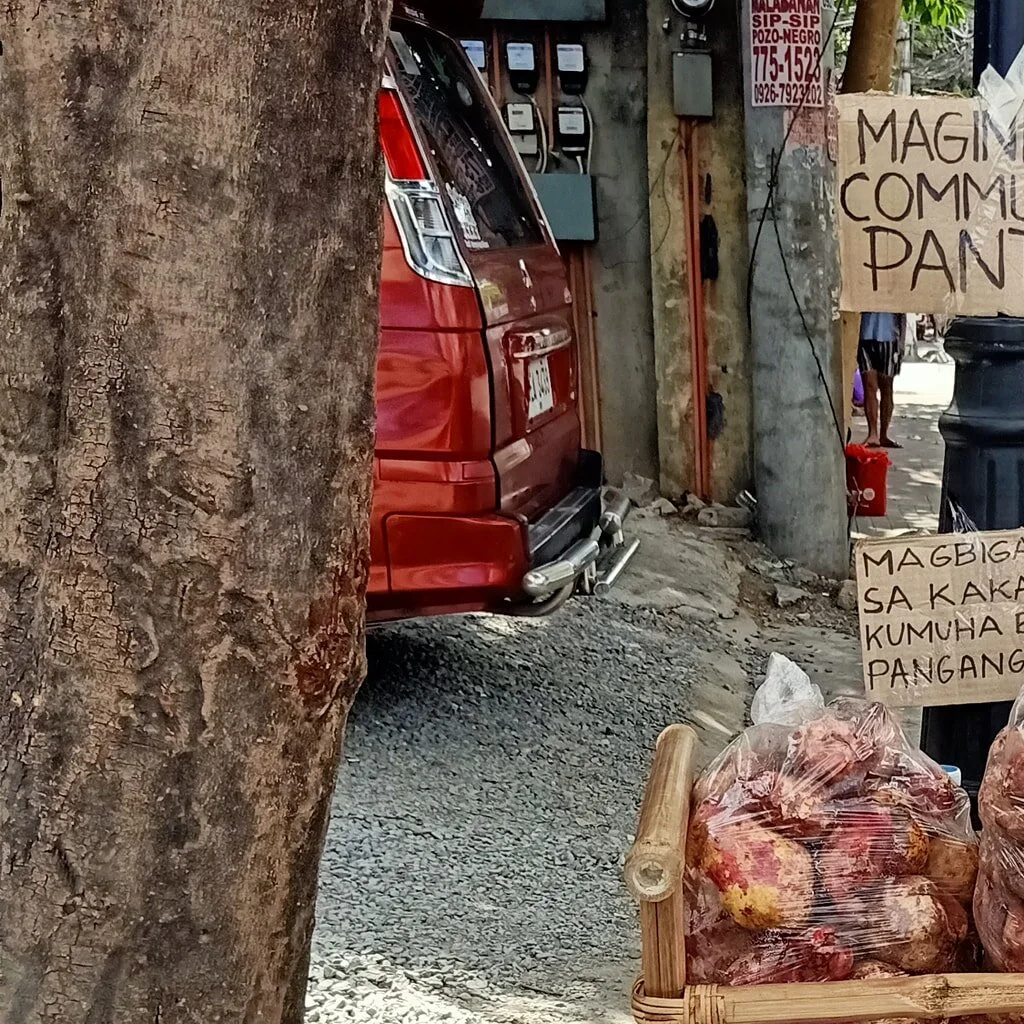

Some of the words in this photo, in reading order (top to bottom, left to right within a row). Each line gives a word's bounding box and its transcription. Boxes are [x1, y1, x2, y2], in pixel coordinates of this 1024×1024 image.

[752, 14, 820, 28] SIP-SIP
[752, 29, 821, 45] POZO-NEGRO
[863, 585, 913, 614] SA
[864, 615, 1008, 651] KUMUHA
